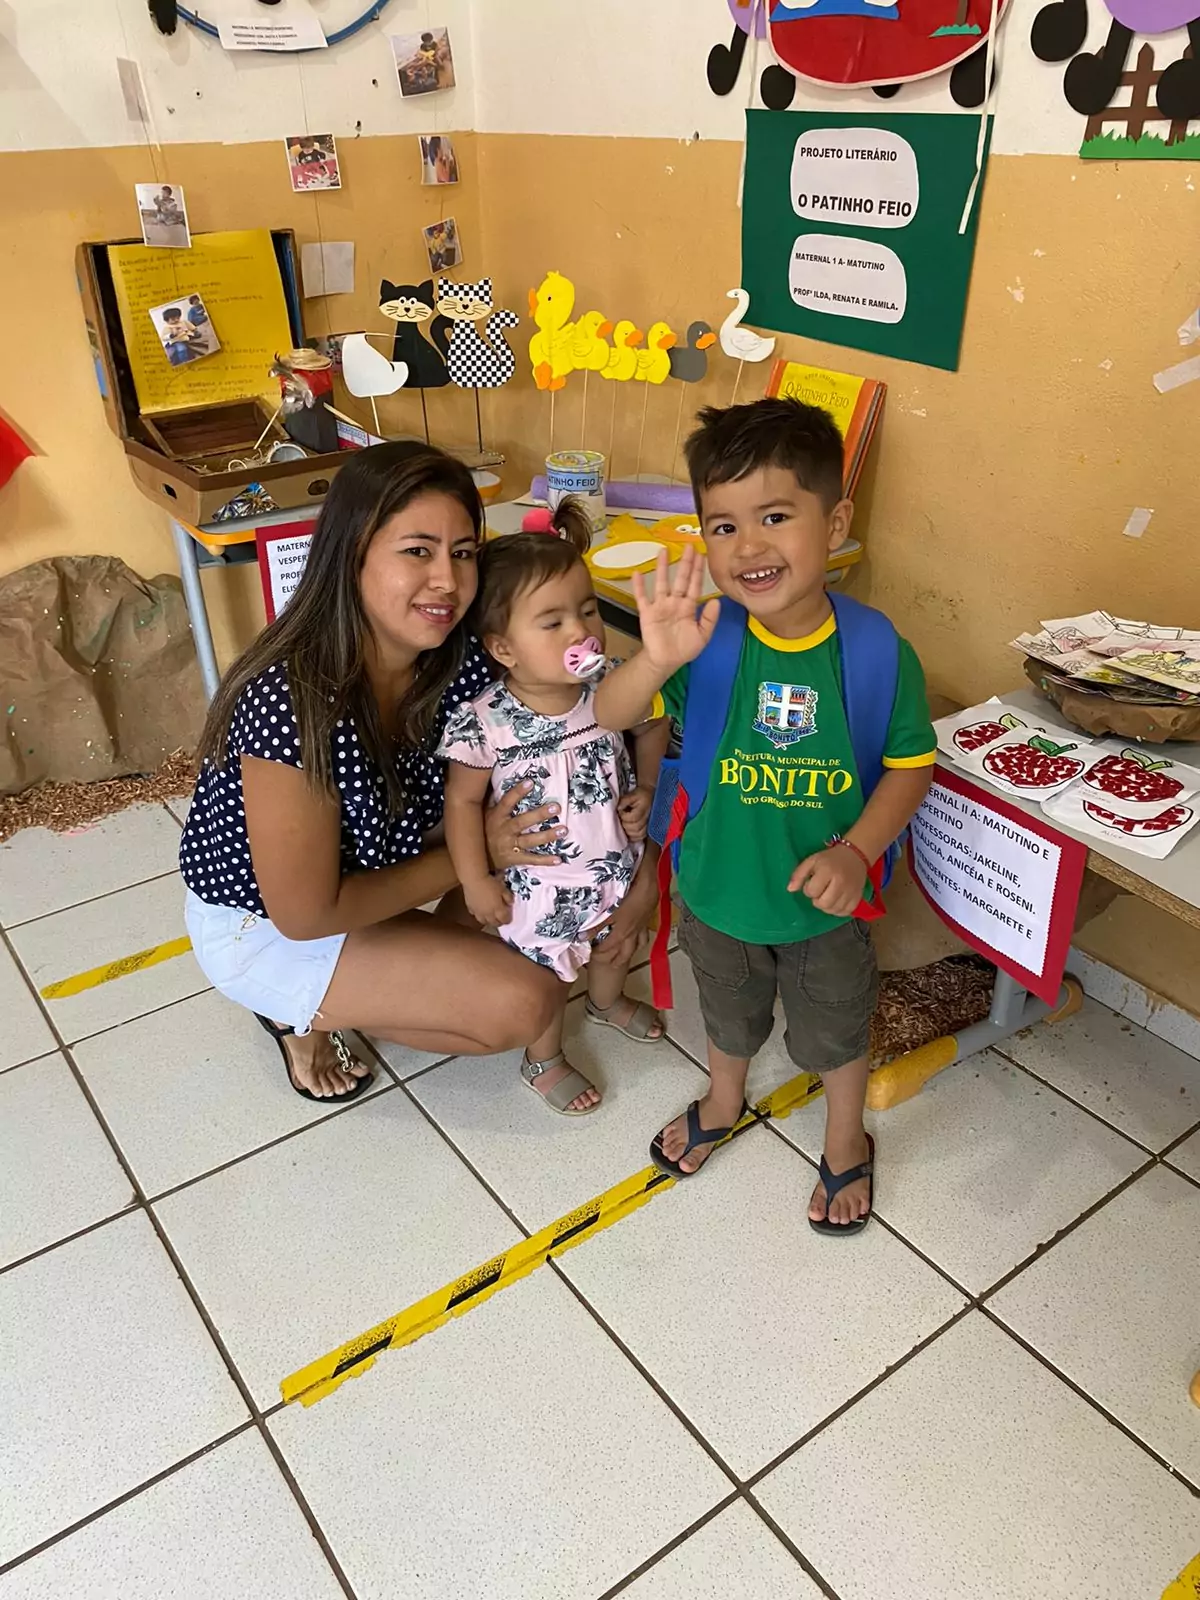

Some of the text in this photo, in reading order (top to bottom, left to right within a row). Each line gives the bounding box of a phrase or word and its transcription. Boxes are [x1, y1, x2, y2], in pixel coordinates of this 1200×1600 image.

[801, 147, 898, 162] PROJETO LITERÁRIO
[798, 194, 912, 217] O PATINHO FEIO
[795, 252, 831, 264] MATERNAL
[832, 257, 837, 265] 1
[846, 260, 885, 271] MATUTINO
[813, 291, 831, 301] ILDA,
[832, 294, 860, 305] RENATA
[868, 299, 899, 311] RAMILA.
[785, 381, 794, 395] O
[829, 391, 850, 409] FEIO
[576, 478, 596, 487] FEIO
[777, 756, 827, 767] MUNICIPAL
[719, 757, 853, 797] BONITO
[790, 799, 804, 808] DO
[805, 800, 824, 809] SUL
[961, 803, 968, 814] II
[970, 809, 981, 821] A:
[982, 815, 1040, 854] MATUTINO
[1042, 849, 1050, 860] E
[914, 812, 972, 857] ROFESSORAS:
[973, 852, 1021, 888] JAKELINE,
[947, 855, 984, 884] ANICÉIA
[987, 878, 993, 889] E
[996, 883, 1036, 915] ROSENI.
[963, 889, 1024, 934] MARGARETE
[1026, 928, 1033, 940] E
